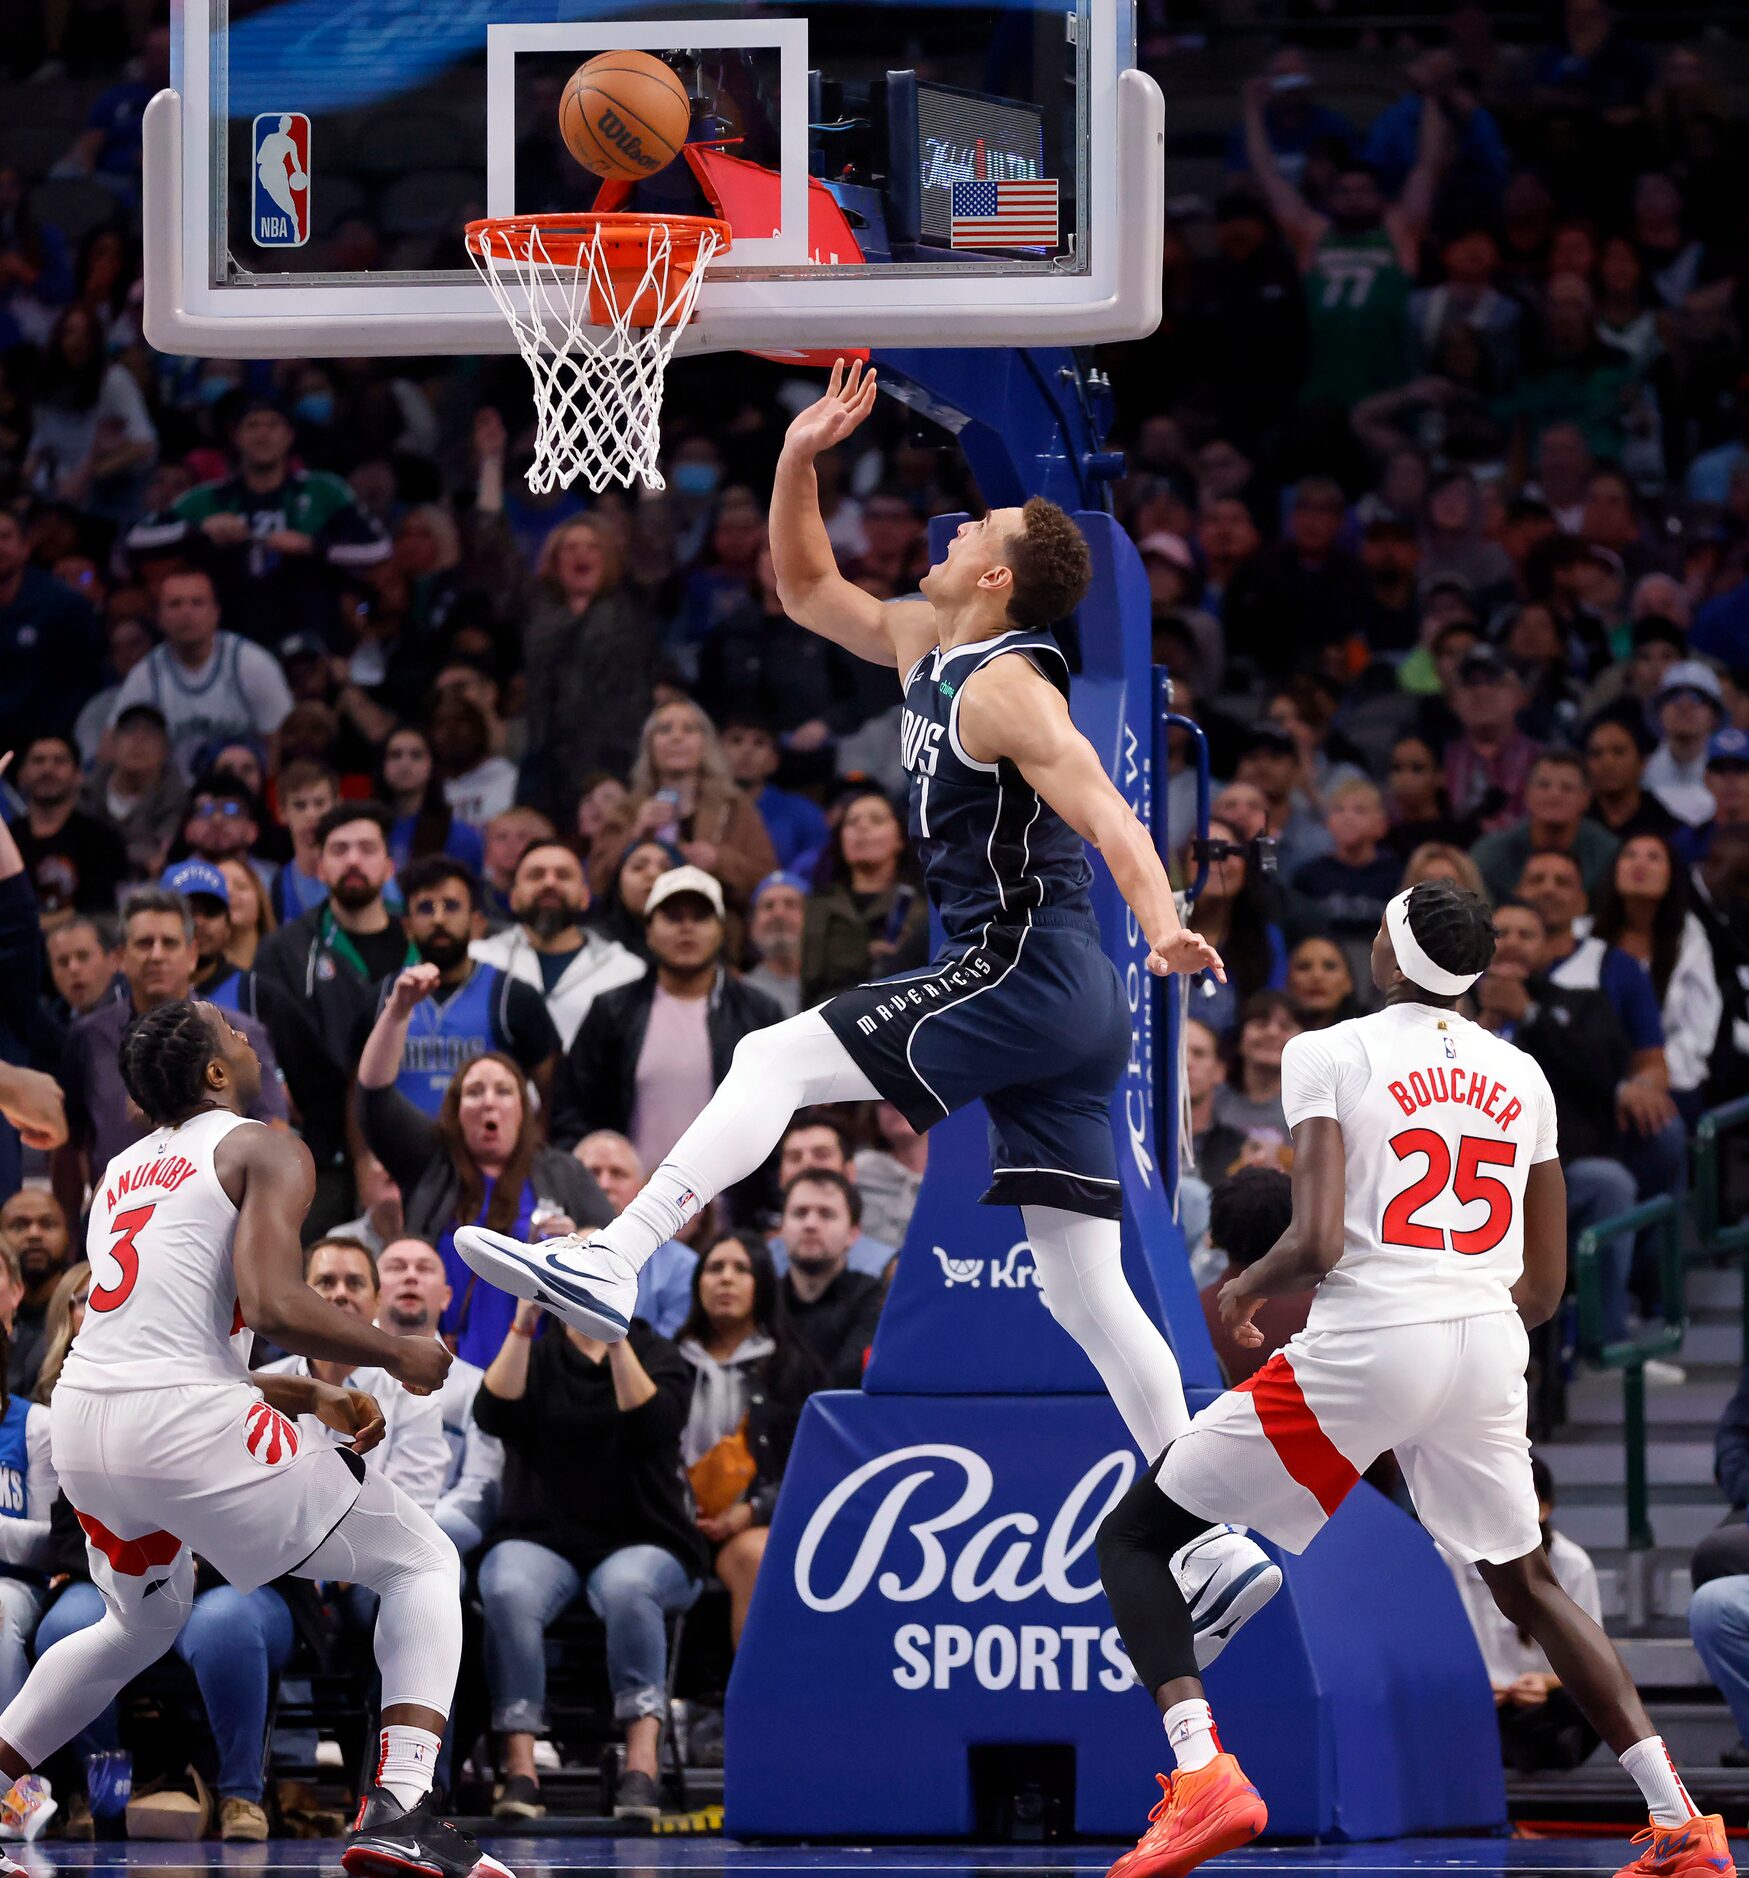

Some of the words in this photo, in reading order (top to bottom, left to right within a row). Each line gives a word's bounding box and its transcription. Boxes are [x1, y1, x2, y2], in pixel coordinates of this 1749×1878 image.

[597, 107, 662, 170] Wilson
[261, 217, 288, 238] NBA
[901, 706, 946, 777] AVS
[1124, 722, 1147, 1145] CHOCW
[1388, 1067, 1522, 1132] BOUCHER
[106, 1155, 197, 1215] ANUNOBY
[1381, 1128, 1517, 1255] 25
[89, 1203, 157, 1313] 3
[795, 1443, 1136, 1612] Bal
[892, 1623, 1136, 1692] SPORTS
